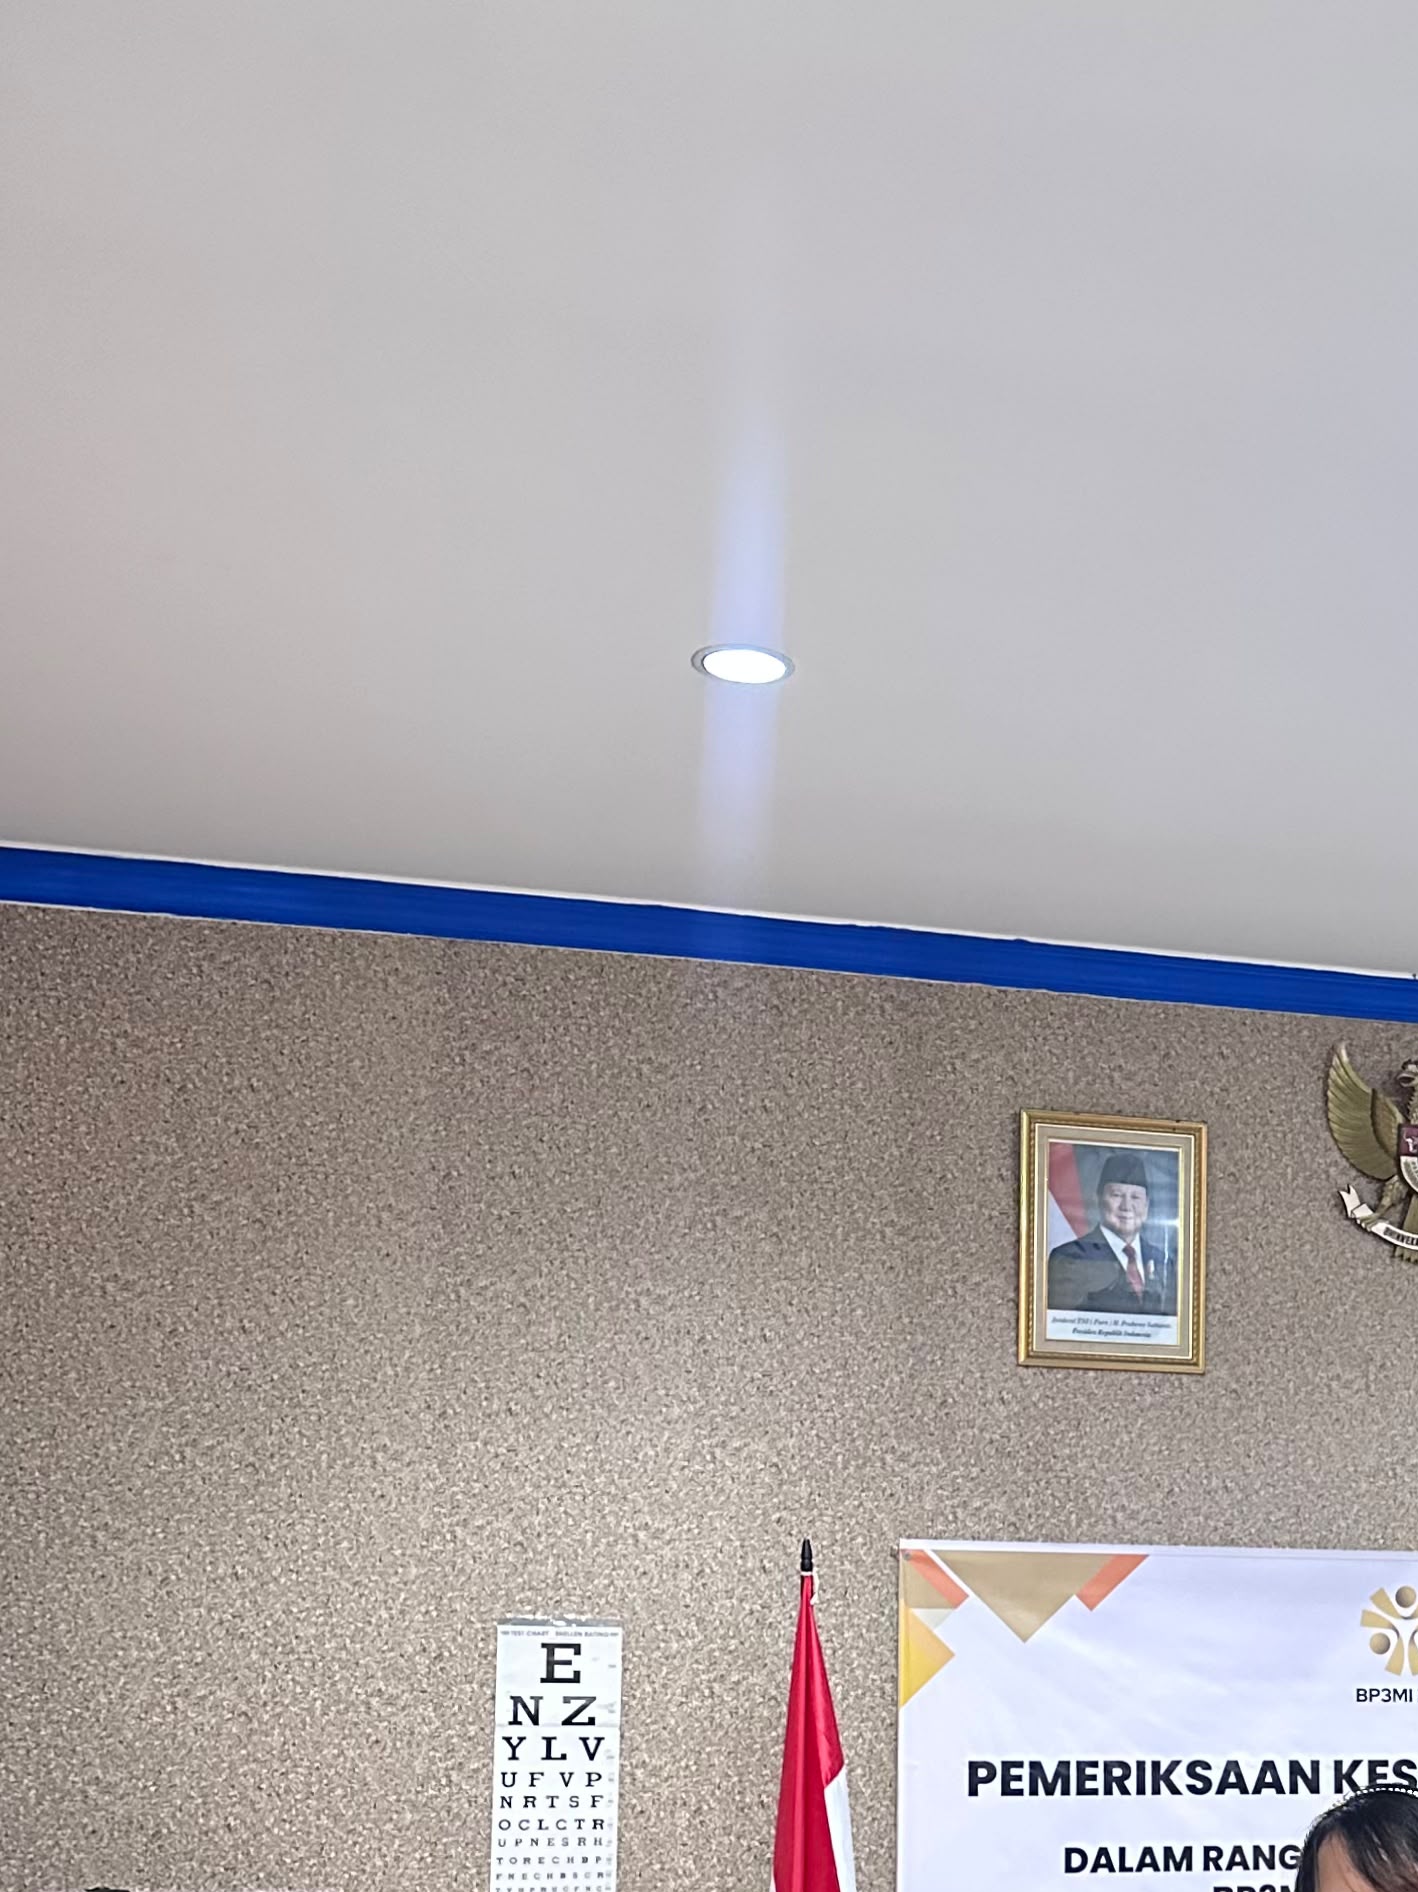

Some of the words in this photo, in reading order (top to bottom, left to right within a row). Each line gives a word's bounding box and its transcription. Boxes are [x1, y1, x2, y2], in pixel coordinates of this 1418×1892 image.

[540, 1643, 581, 1683] E
[1356, 1688, 1413, 1702] BP3MI
[508, 1695, 544, 1726] N
[561, 1696, 597, 1726] Z
[502, 1736, 526, 1760] Y
[541, 1736, 567, 1760] L
[579, 1737, 605, 1761] V
[501, 1772, 517, 1788] U
[529, 1772, 544, 1787] F
[559, 1772, 574, 1787] V
[585, 1772, 602, 1787] P
[967, 1759, 1321, 1797] PEMERIKSAAN
[500, 1796, 513, 1808] N
[523, 1796, 536, 1808] R
[546, 1795, 559, 1808] T
[569, 1796, 579, 1808] S
[591, 1795, 603, 1808] F
[499, 1819, 511, 1831] O
[518, 1819, 530, 1831] C
[538, 1819, 549, 1830] L
[556, 1819, 566, 1830] C
[574, 1819, 585, 1830] T
[592, 1819, 604, 1830] R
[1064, 1845, 1193, 1874] DALAM
[1203, 1844, 1302, 1871] RANG
